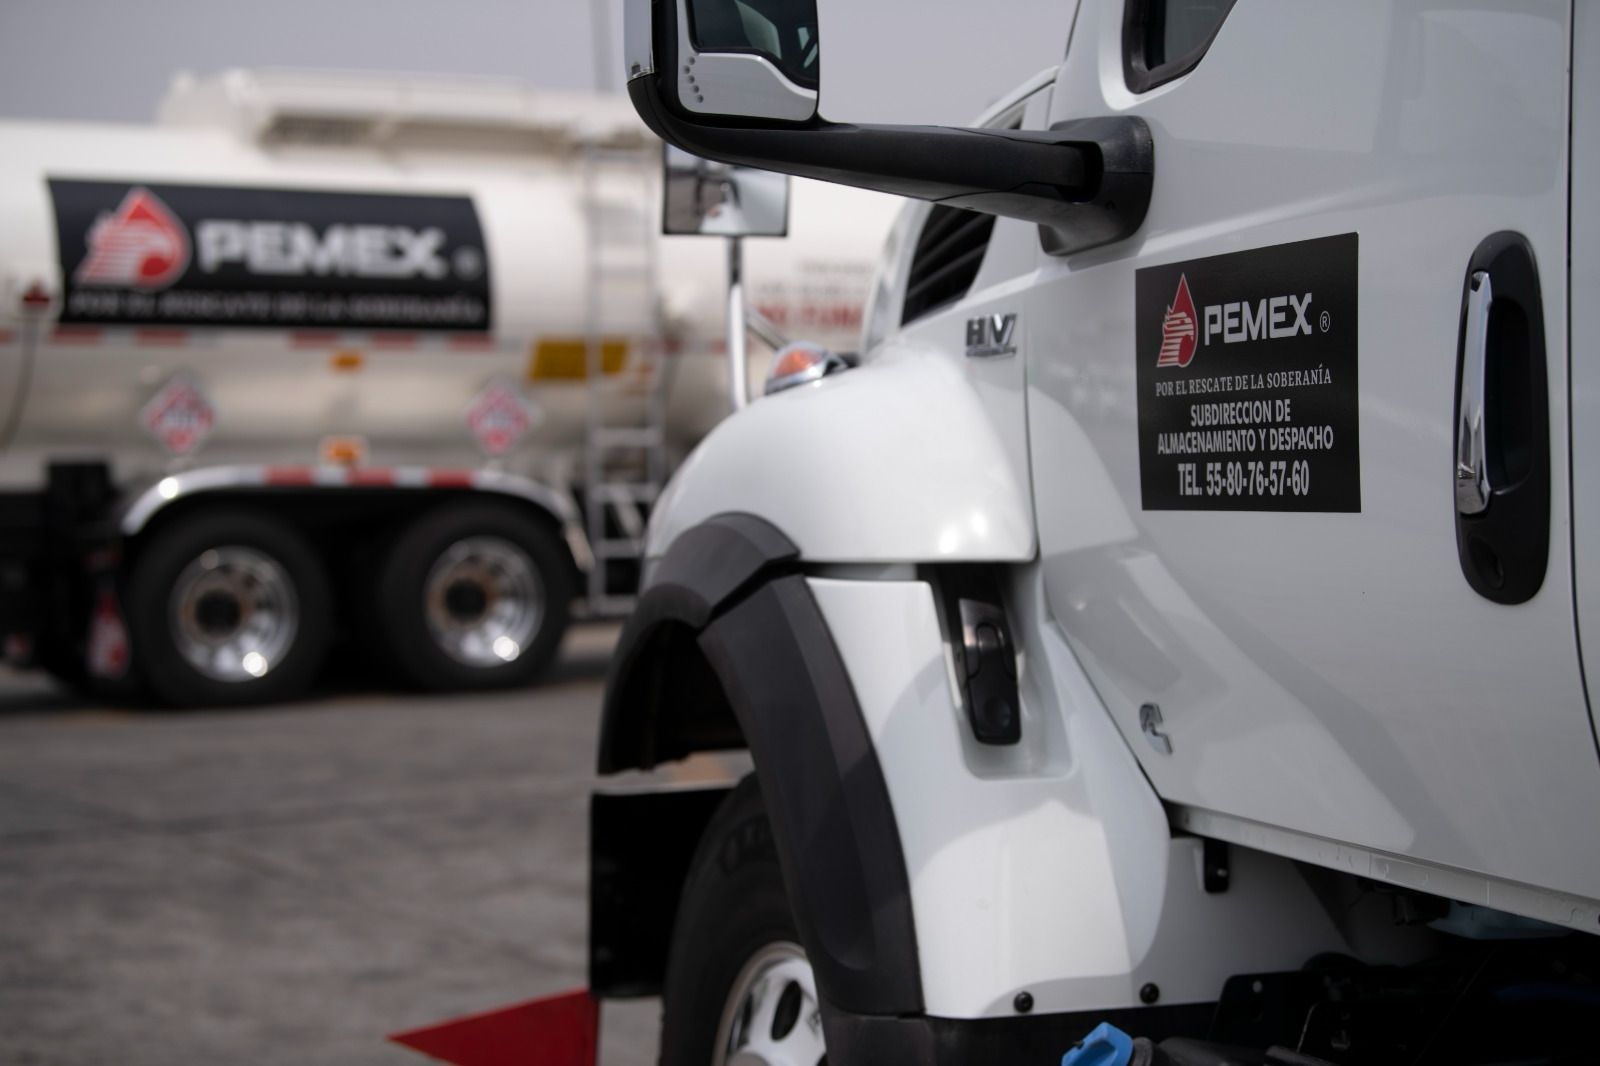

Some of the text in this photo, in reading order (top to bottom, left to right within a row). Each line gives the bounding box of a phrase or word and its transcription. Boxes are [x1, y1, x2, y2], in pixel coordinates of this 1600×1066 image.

[197, 220, 447, 278] PEMEX
[965, 312, 1017, 347] HV
[1204, 292, 1312, 346] PEMEX
[1155, 364, 1332, 397] POR EL RESCATE DE LA SOBERANÍA
[1190, 399, 1291, 427] SUBDIRECCION DE
[1157, 425, 1334, 455] ALMACENAMIENTO Y DESPACHO
[1178, 460, 1310, 496] TEL. 55-80-76-57-60
